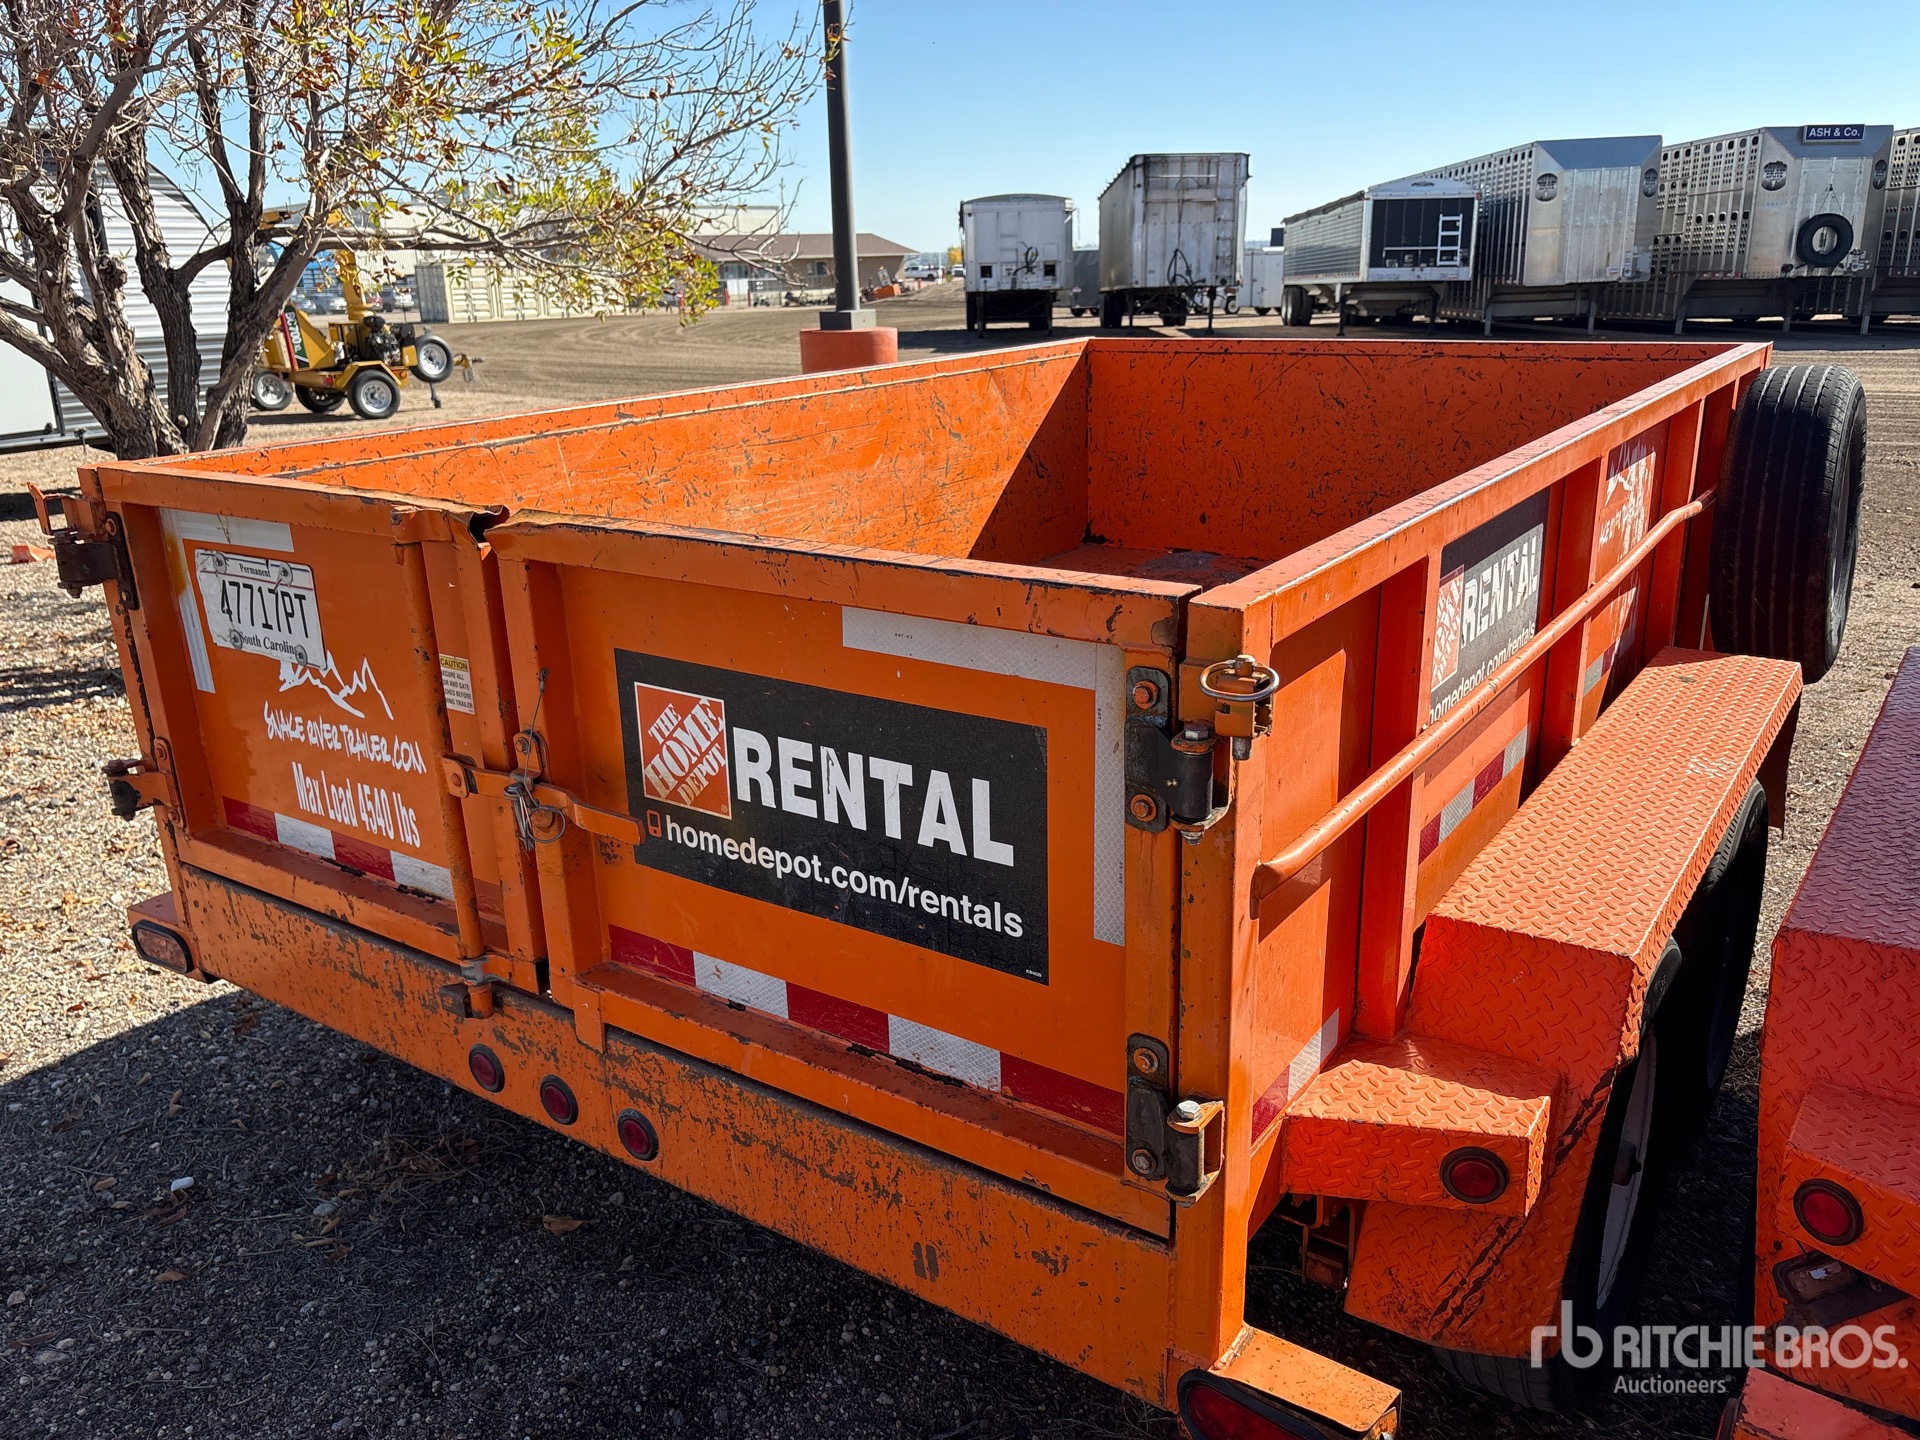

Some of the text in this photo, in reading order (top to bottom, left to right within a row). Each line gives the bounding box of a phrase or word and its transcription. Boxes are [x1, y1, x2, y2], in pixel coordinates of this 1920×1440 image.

[1808, 126, 1861, 138] ASH & Co.
[238, 562, 272, 578] Permanent
[1461, 535, 1538, 650] RENTAL
[220, 578, 309, 640] 47717PT
[440, 657, 468, 670] CAUTION
[644, 697, 725, 800] HOME
[648, 702, 682, 745] THE
[291, 760, 421, 849] Max Load 4540 lbs
[676, 742, 728, 807] DEPOT
[732, 726, 1014, 868] RENTAL
[666, 814, 1024, 938] homedepot.com/rentals
